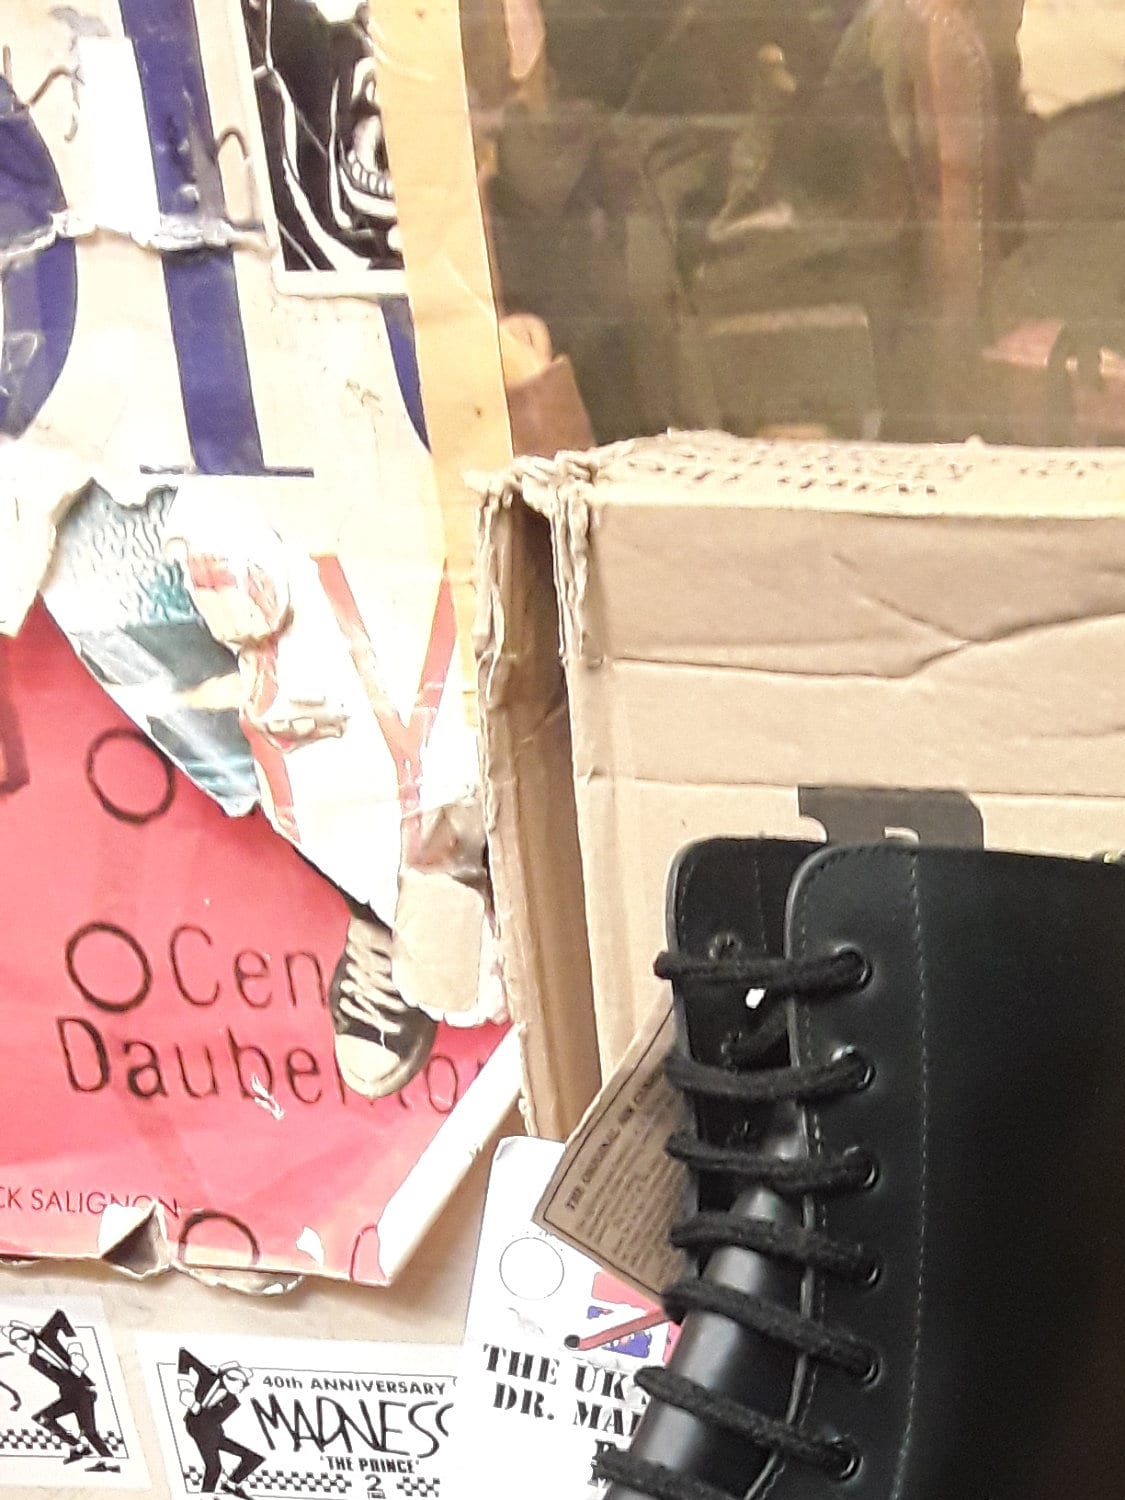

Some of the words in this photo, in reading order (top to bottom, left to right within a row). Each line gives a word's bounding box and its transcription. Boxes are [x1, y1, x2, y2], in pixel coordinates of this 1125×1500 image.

[483, 1343, 561, 1385] THE
[262, 1375, 304, 1389] 40th
[310, 1377, 446, 1396] ANNIVERSARY
[492, 1382, 555, 1421] DR.
